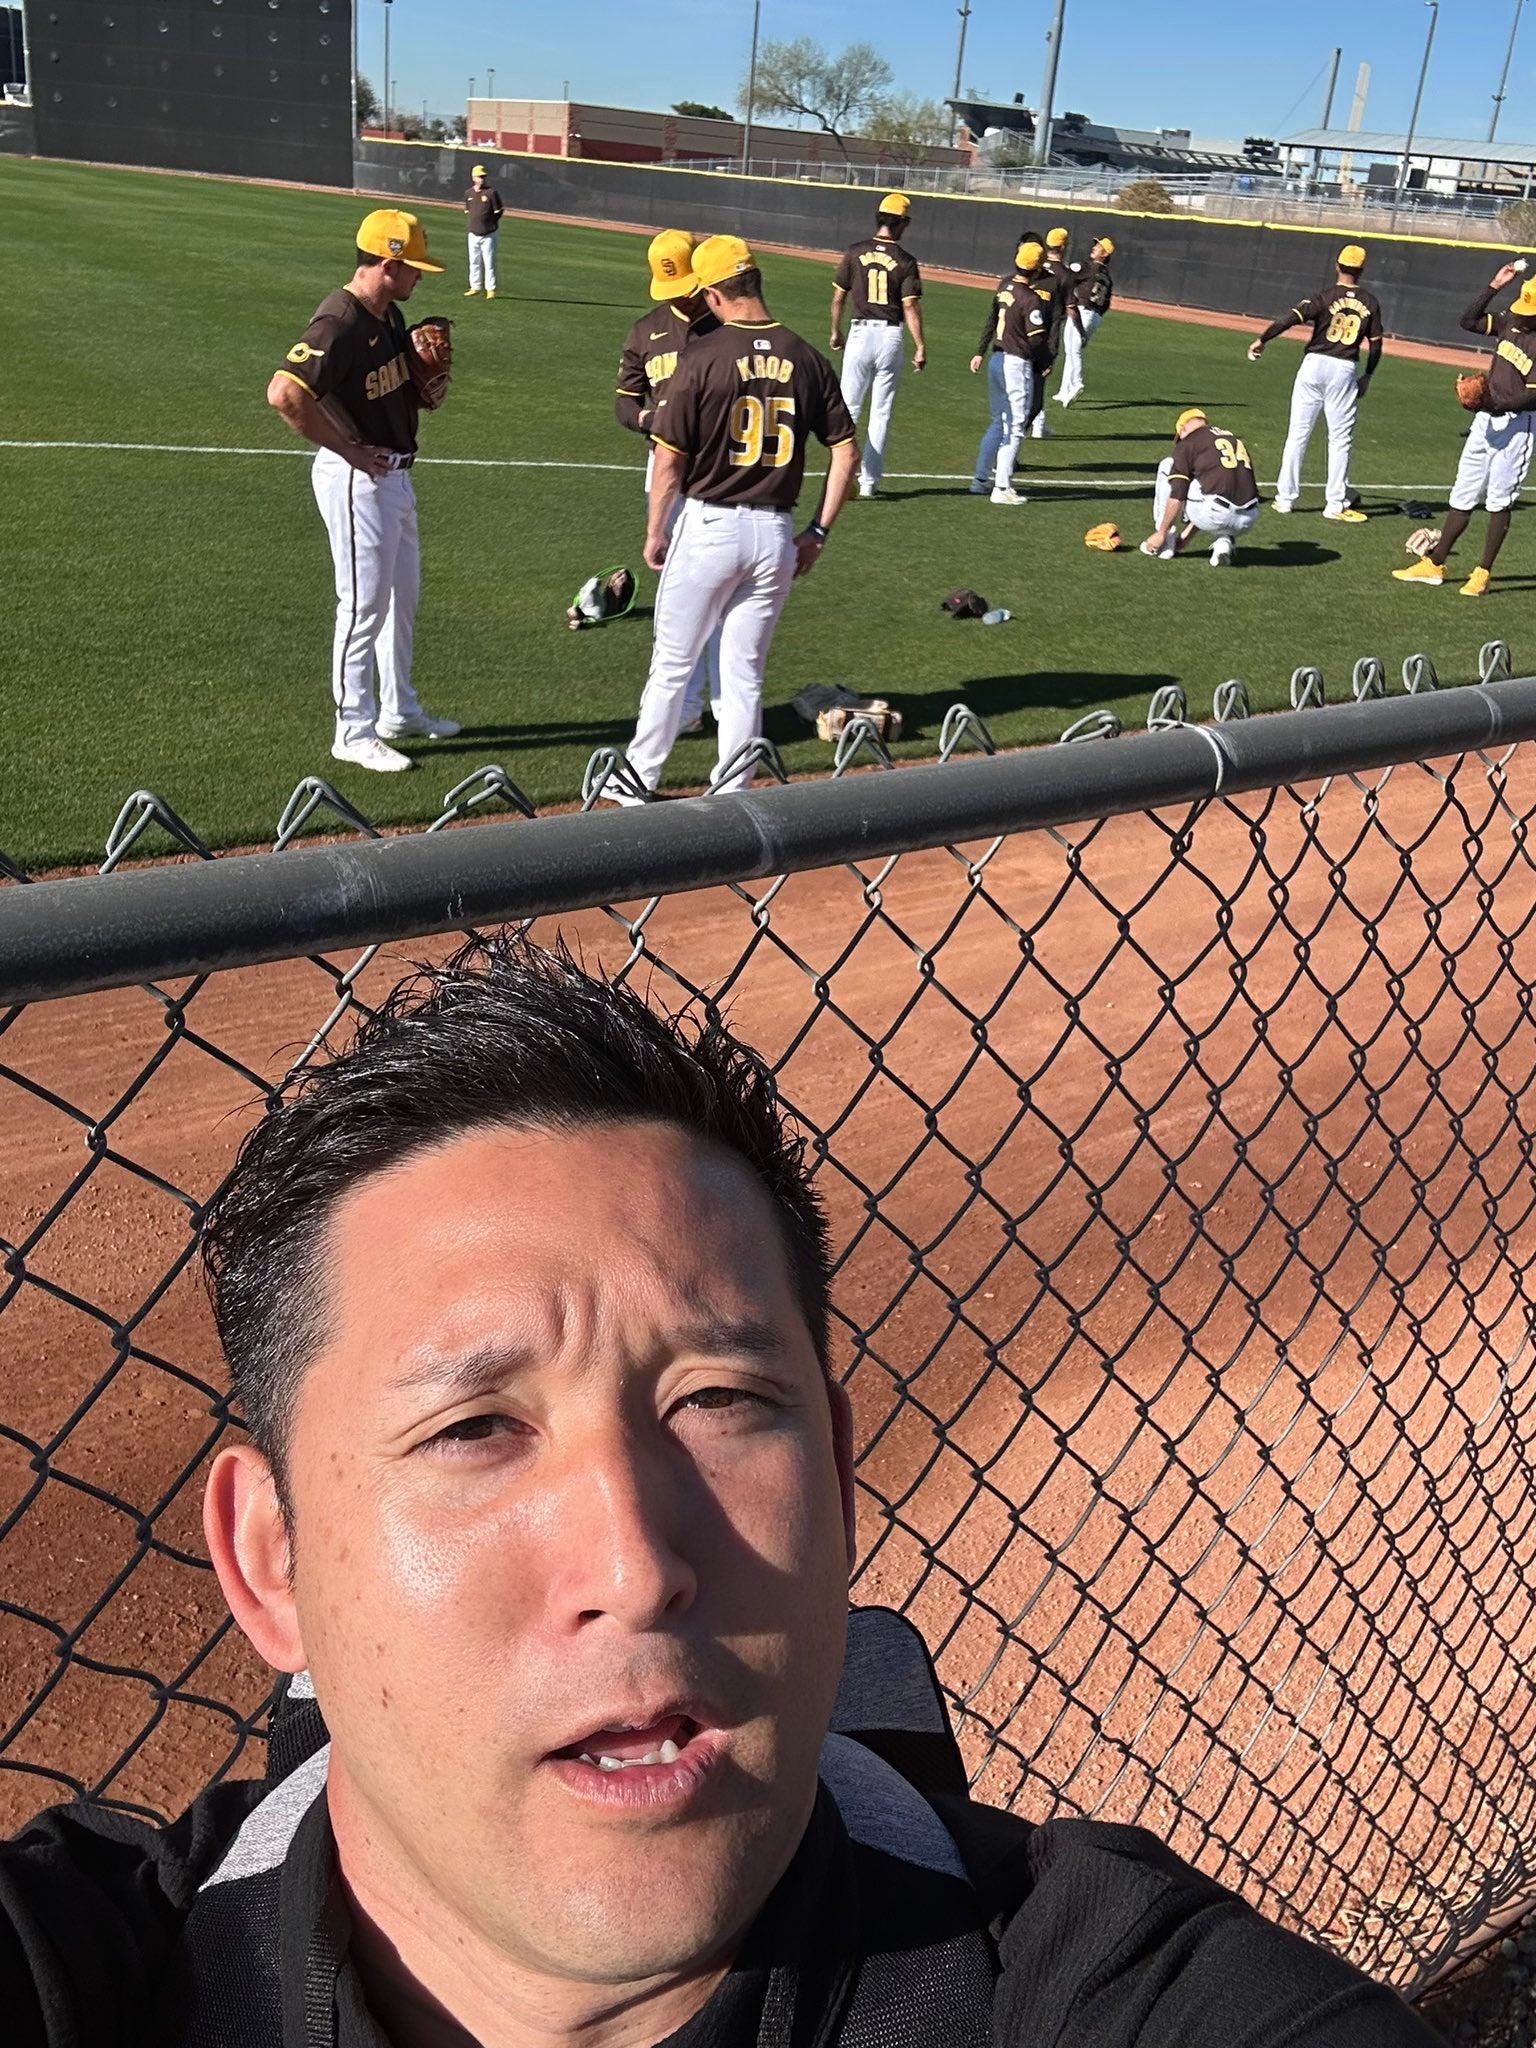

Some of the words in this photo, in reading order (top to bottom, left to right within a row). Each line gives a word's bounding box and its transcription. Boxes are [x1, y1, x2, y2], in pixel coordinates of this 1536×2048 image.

[867, 268, 889, 305] 11
[736, 354, 794, 384] KROB
[729, 395, 796, 468] 95
[1214, 438, 1252, 470] 34
